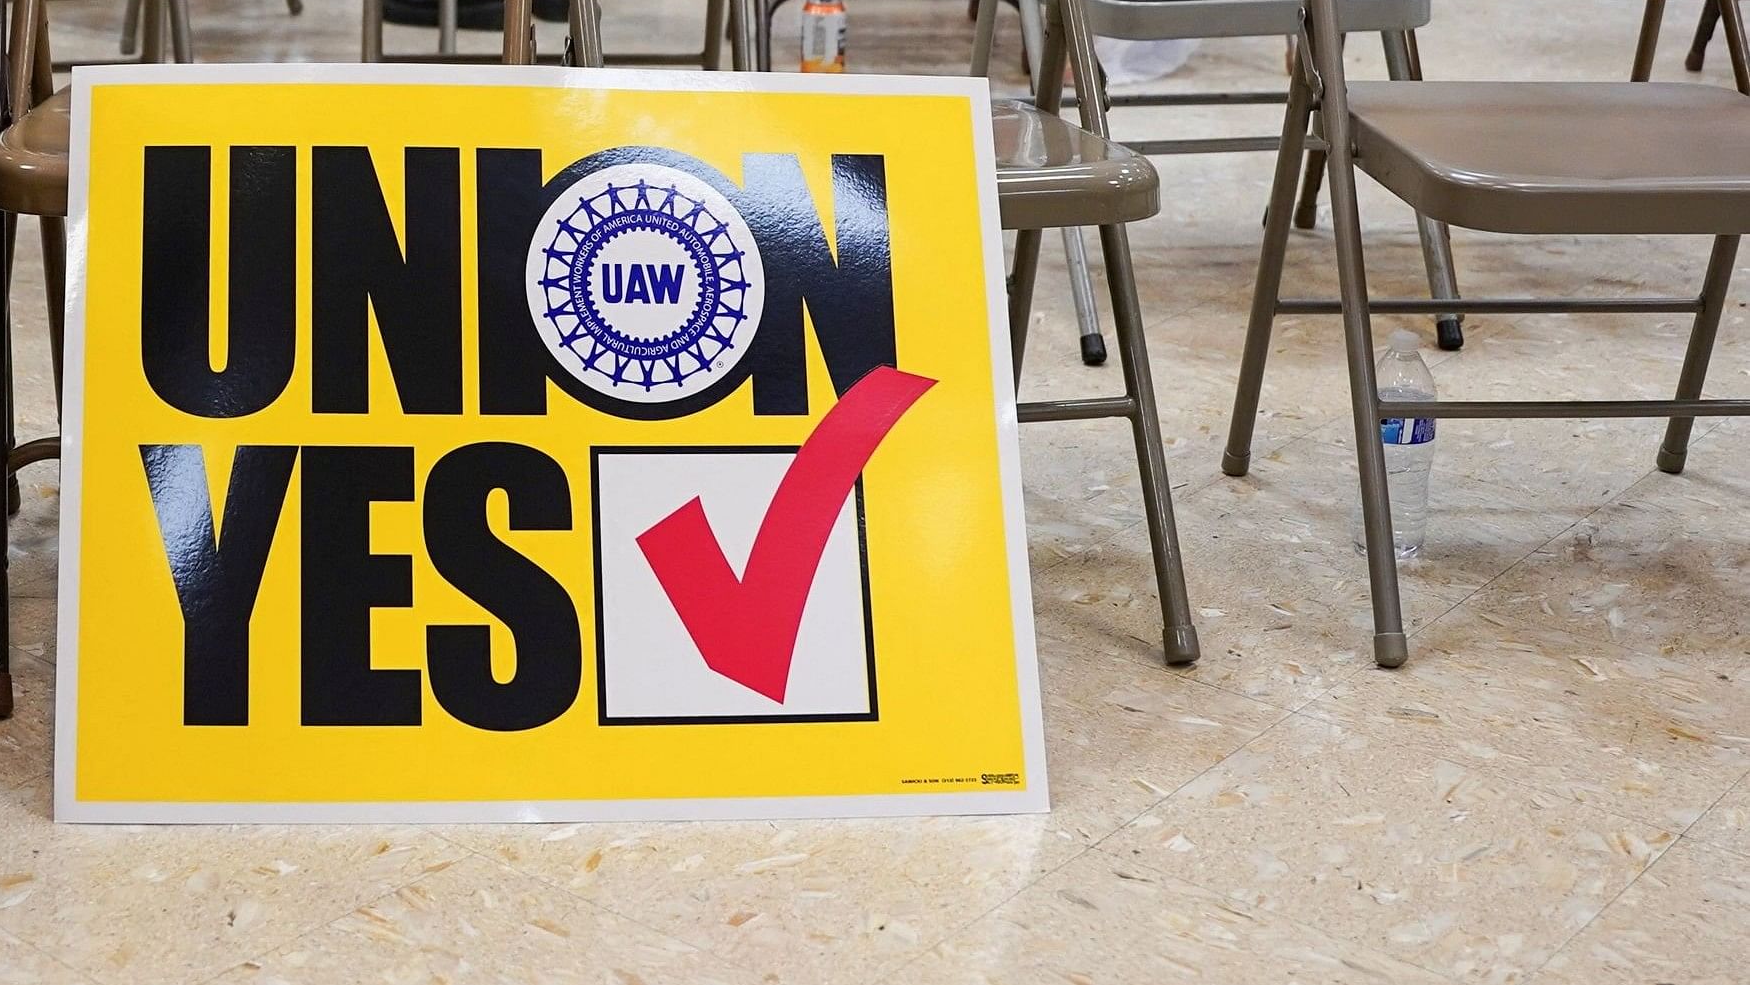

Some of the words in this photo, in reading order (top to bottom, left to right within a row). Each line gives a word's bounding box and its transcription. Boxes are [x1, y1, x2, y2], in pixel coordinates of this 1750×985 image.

[590, 229, 603, 242] OF
[603, 214, 643, 233] AMERICA
[645, 215, 679, 231] UNITED
[573, 240, 594, 284] WORKERS
[679, 228, 715, 284] AUTOMOBILE,
[141, 145, 897, 420] UNION
[602, 263, 685, 304] UAW
[573, 285, 603, 336] IMPLEMENT
[687, 286, 715, 337] AEROSPACE
[602, 332, 669, 356] AGRICULTURAL
[670, 333, 690, 349] AND
[139, 441, 582, 733] YES
